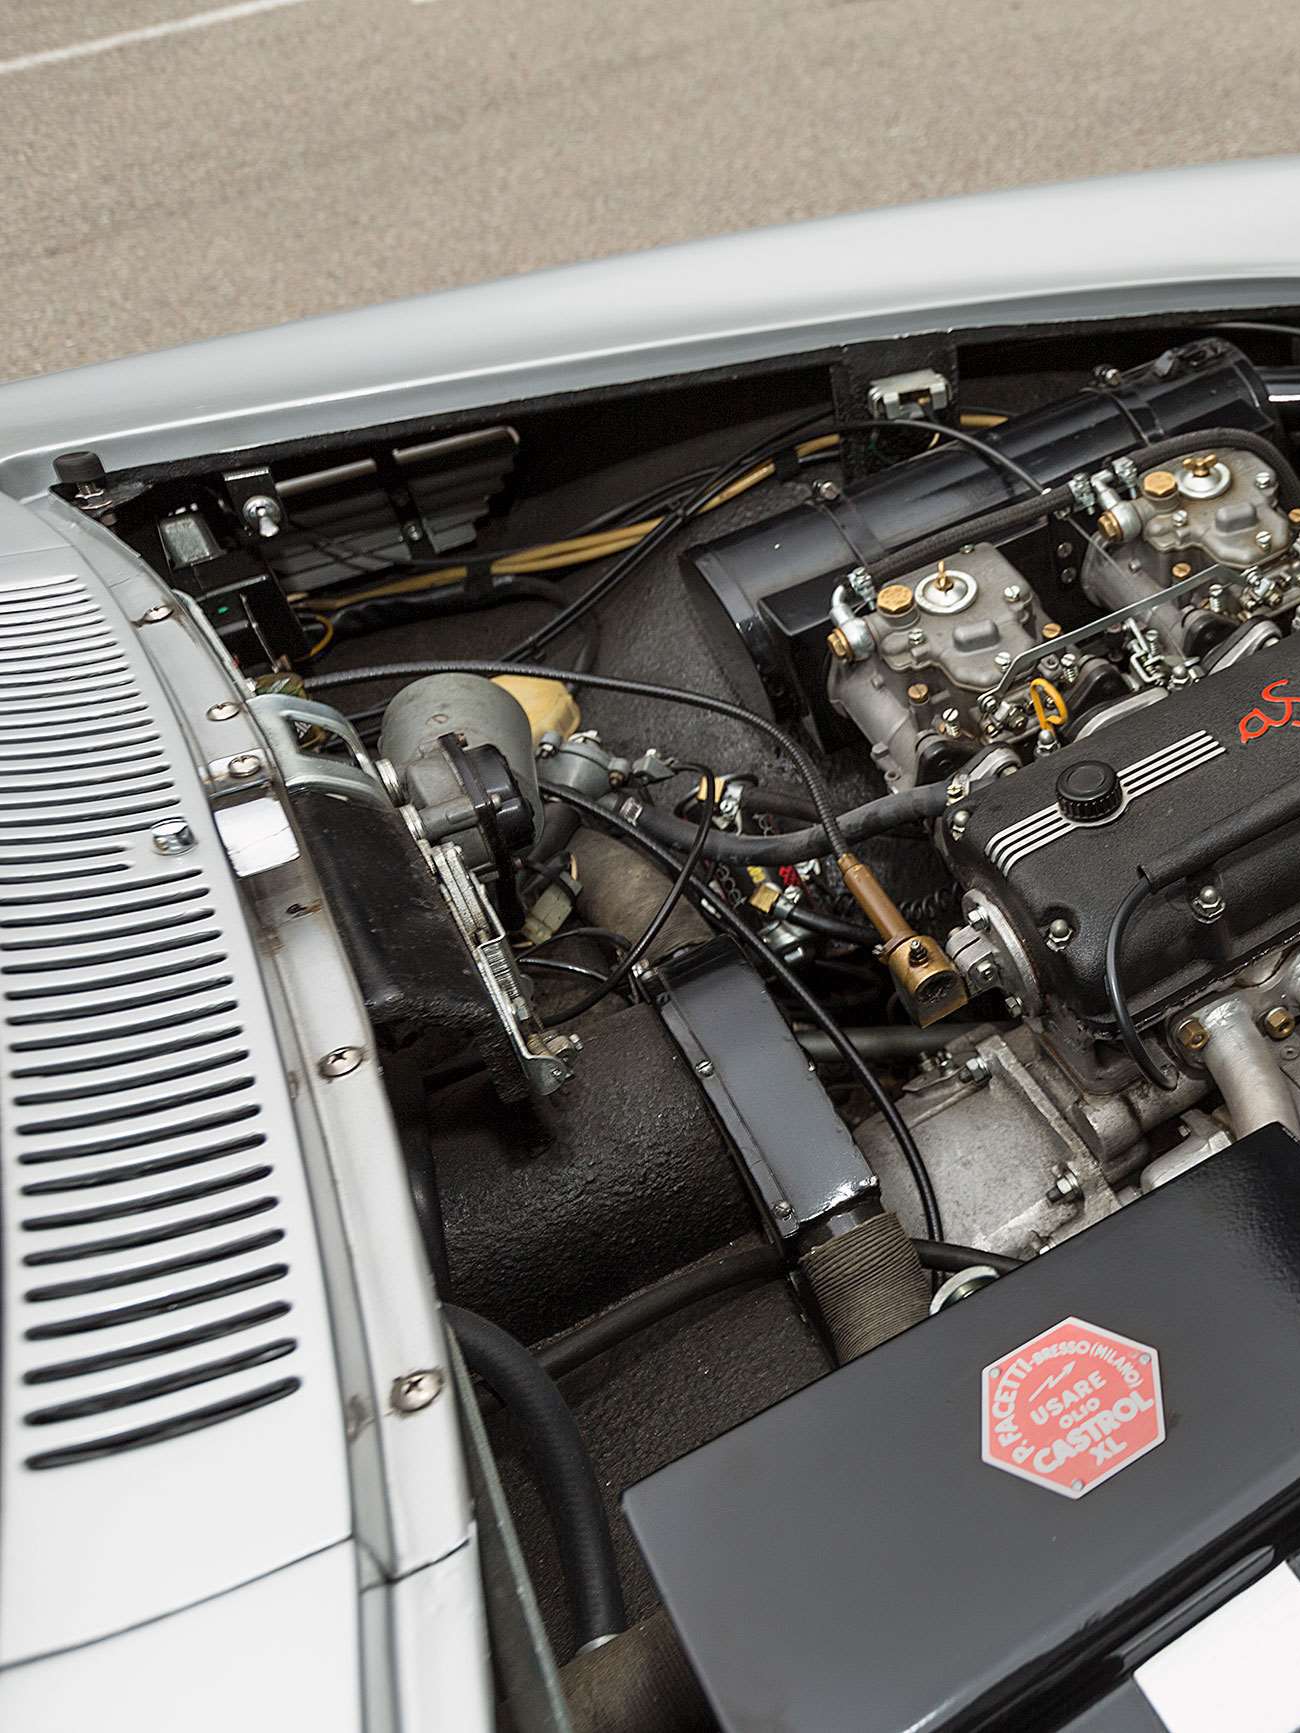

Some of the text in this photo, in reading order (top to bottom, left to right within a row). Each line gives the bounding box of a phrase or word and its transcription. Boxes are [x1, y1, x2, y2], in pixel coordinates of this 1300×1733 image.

[1030, 1370, 1107, 1425] USARE
[1058, 1397, 1101, 1429] OLIO
[1033, 1390, 1154, 1474] CASTROL
[1089, 1436, 1128, 1466] XL
